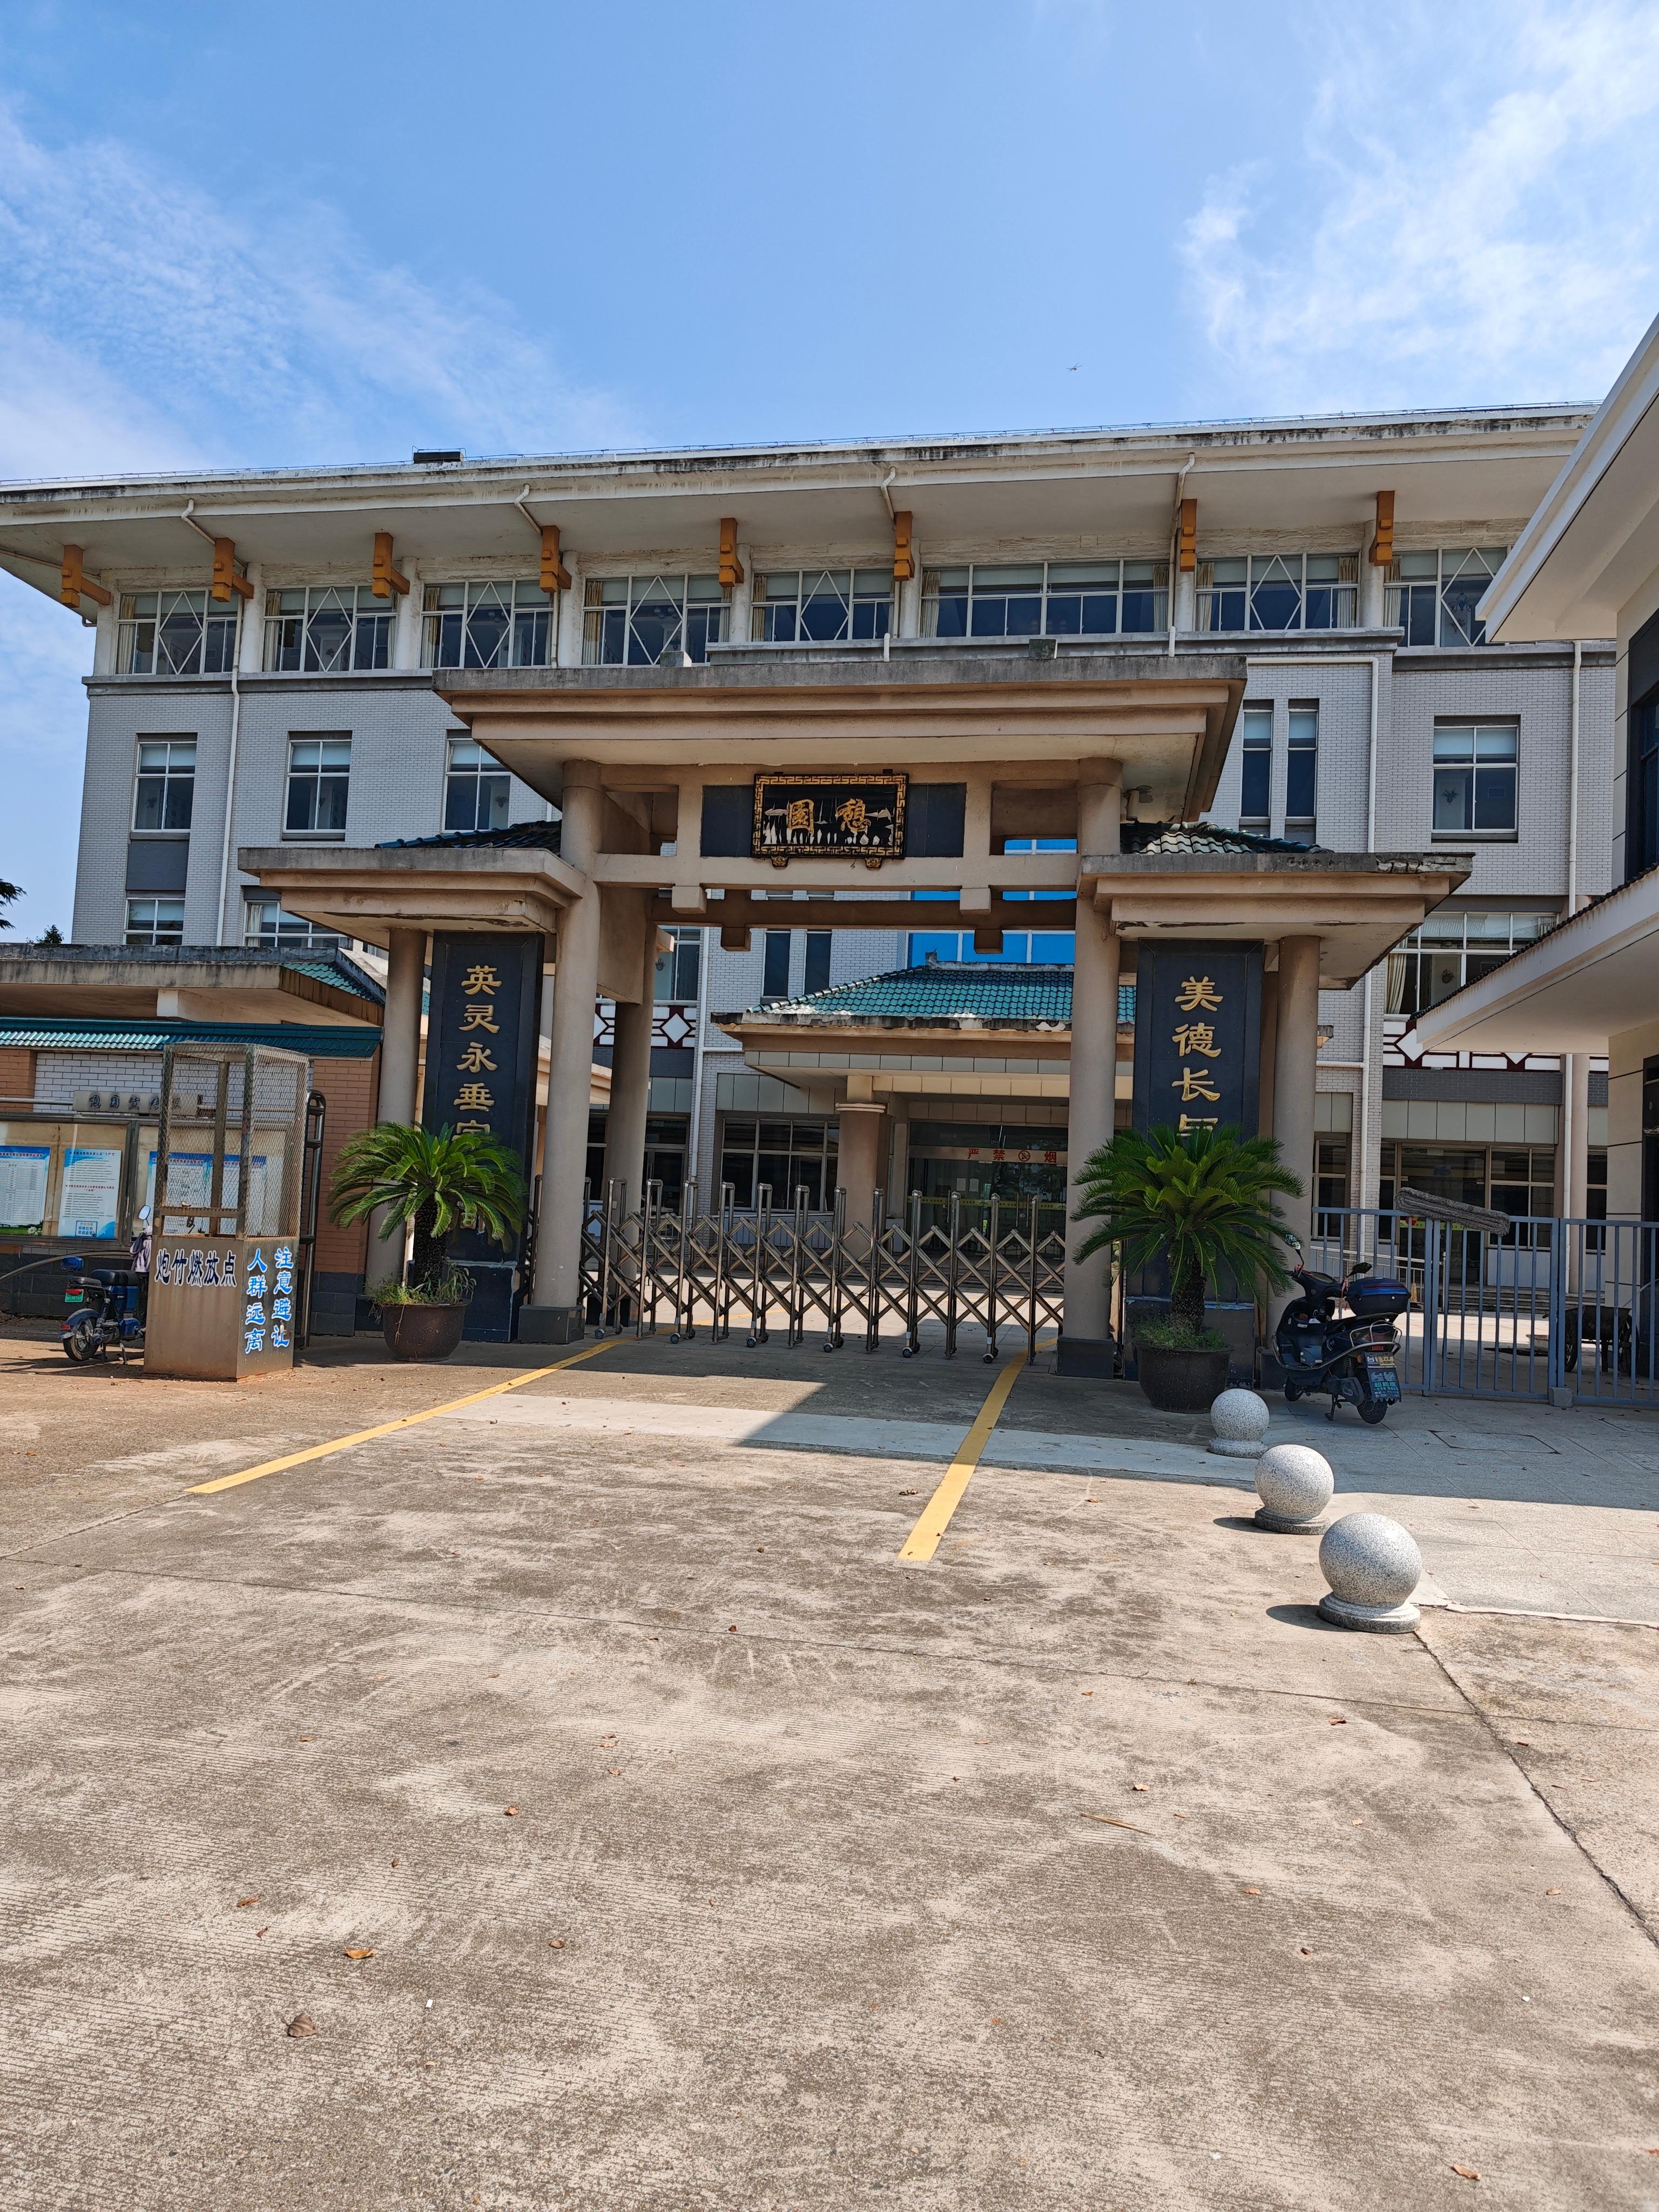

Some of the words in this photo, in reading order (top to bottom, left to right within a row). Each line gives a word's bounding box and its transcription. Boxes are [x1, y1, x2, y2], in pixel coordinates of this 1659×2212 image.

[154, 1248, 237, 1287] 炮竹燃放点
[244, 1247, 268, 1354] 人群远离
[271, 1246, 294, 1347] 注意避让
